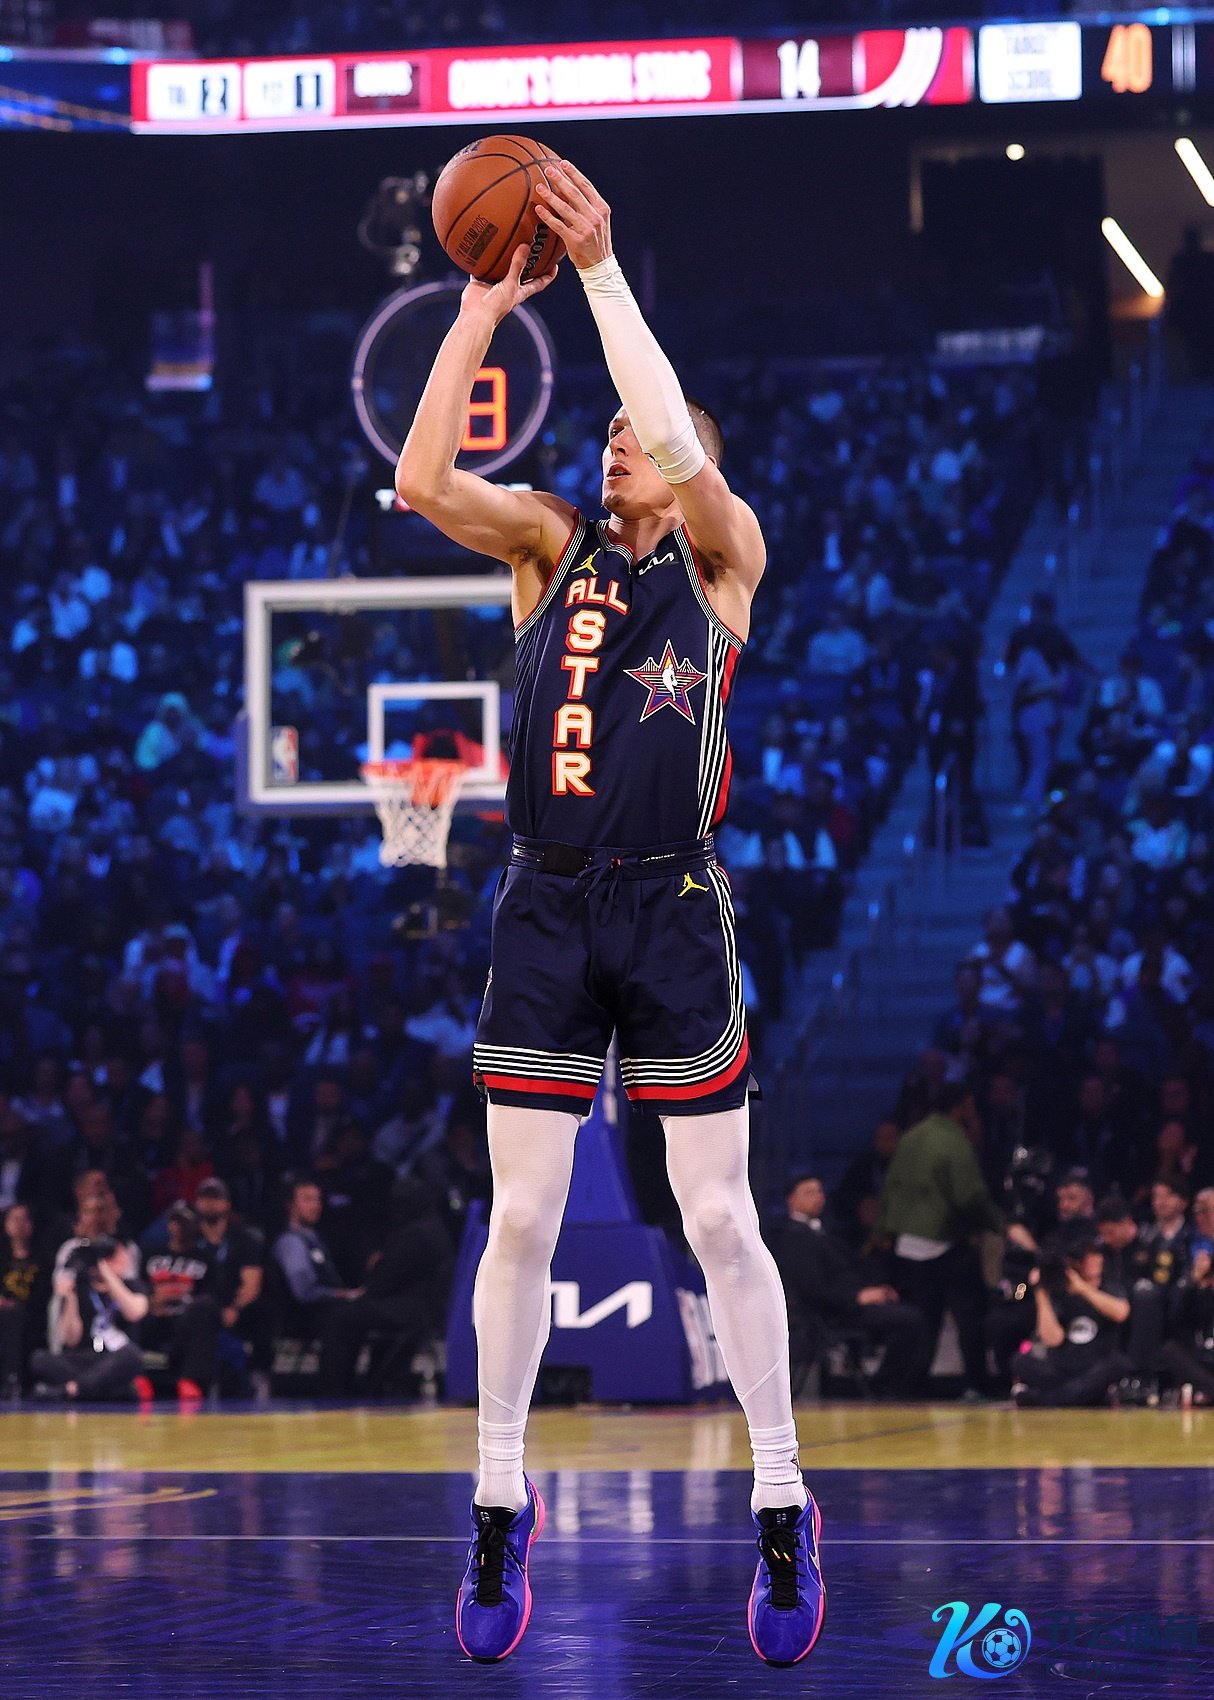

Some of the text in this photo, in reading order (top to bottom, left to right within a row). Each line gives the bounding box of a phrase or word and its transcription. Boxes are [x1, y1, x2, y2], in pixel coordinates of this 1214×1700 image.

[777, 39, 822, 100] 14
[1101, 22, 1153, 94] 40
[473, 215, 490, 233] 2025
[565, 577, 628, 614] ALL
[552, 610, 605, 796] STAR
